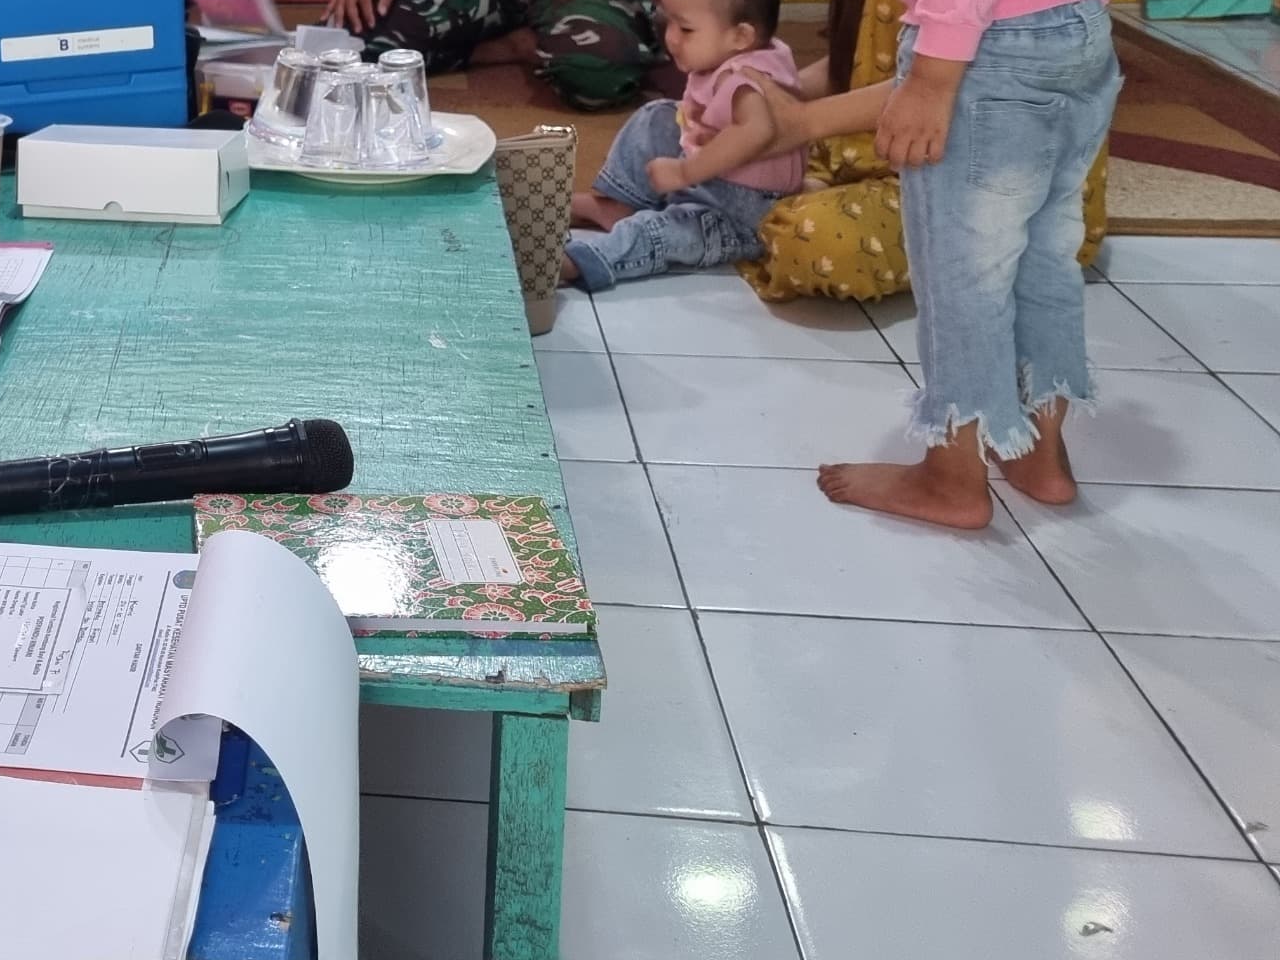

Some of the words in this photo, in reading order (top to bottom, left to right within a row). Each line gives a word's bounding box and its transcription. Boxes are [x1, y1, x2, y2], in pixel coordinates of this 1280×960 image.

[178, 594, 189, 609] UPTD
[174, 609, 187, 626] PUSAT
[167, 627, 182, 659] KESEHATAN
